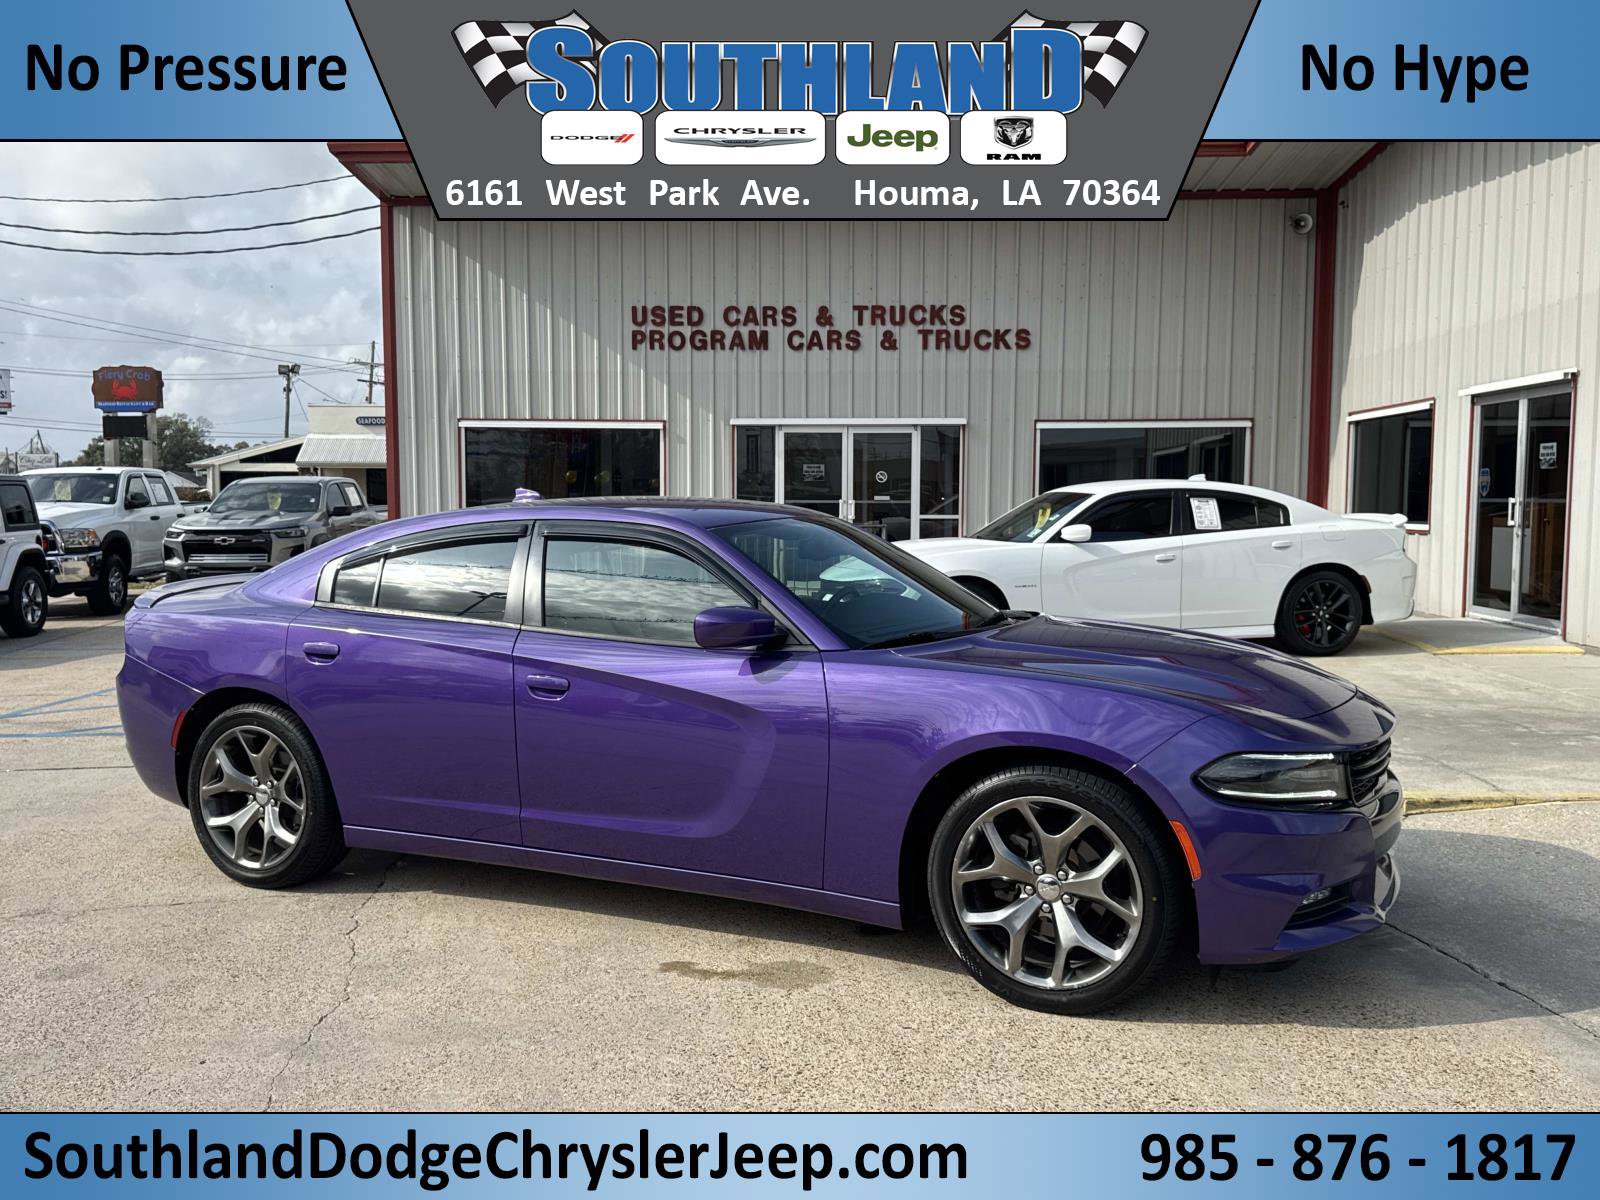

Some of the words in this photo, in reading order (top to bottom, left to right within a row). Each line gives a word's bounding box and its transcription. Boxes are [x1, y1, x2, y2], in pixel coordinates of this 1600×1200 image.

[631, 305, 704, 327] USED
[722, 305, 798, 327] CARS
[815, 305, 834, 327] &
[853, 304, 966, 327] TRUCKS
[631, 330, 769, 351] PROGRAM
[786, 329, 862, 351] CARS
[880, 330, 898, 351] &
[918, 328, 1031, 350] TRUCKS
